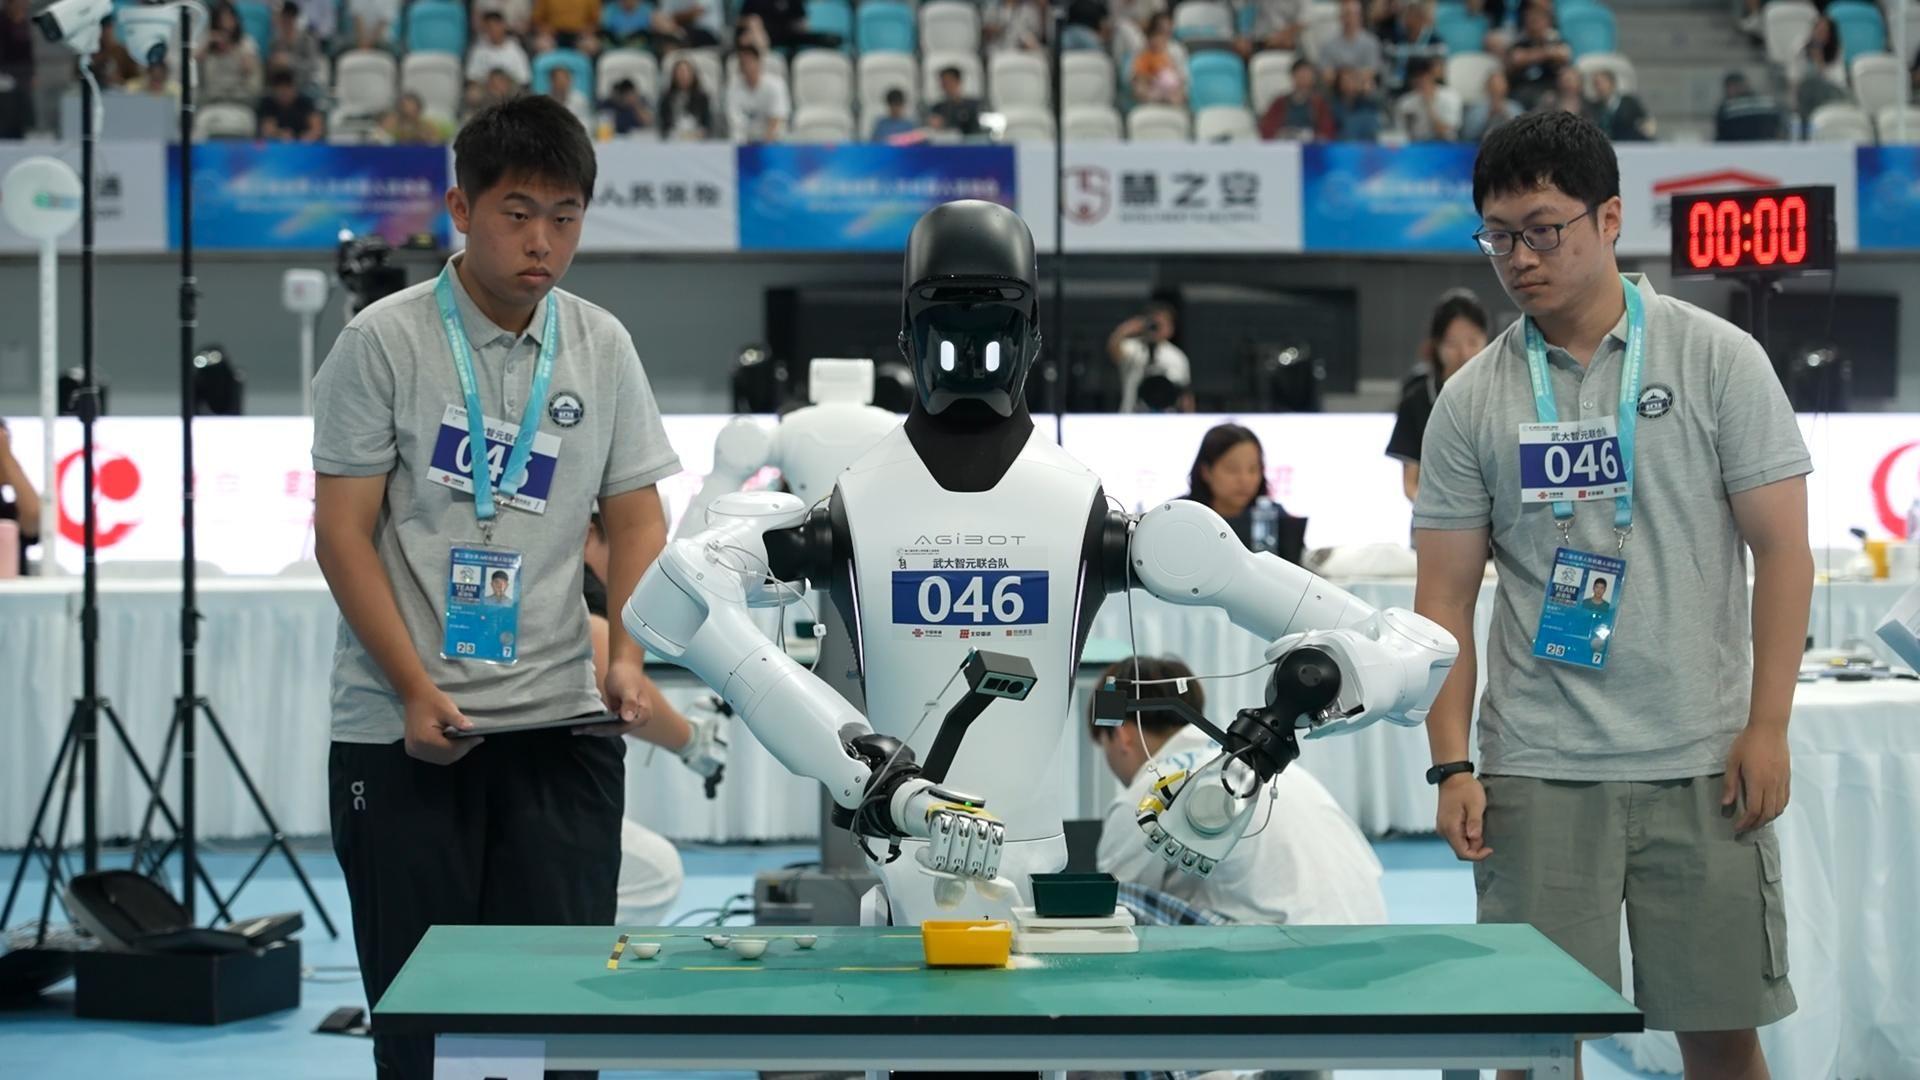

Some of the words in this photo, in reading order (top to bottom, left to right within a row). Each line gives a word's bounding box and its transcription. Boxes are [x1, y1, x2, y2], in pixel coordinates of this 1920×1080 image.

[1689, 196, 1806, 268] 00:00
[1545, 441, 1619, 484] 046
[933, 558, 1009, 569] 武大智元联合队
[918, 575, 1024, 623] 046
